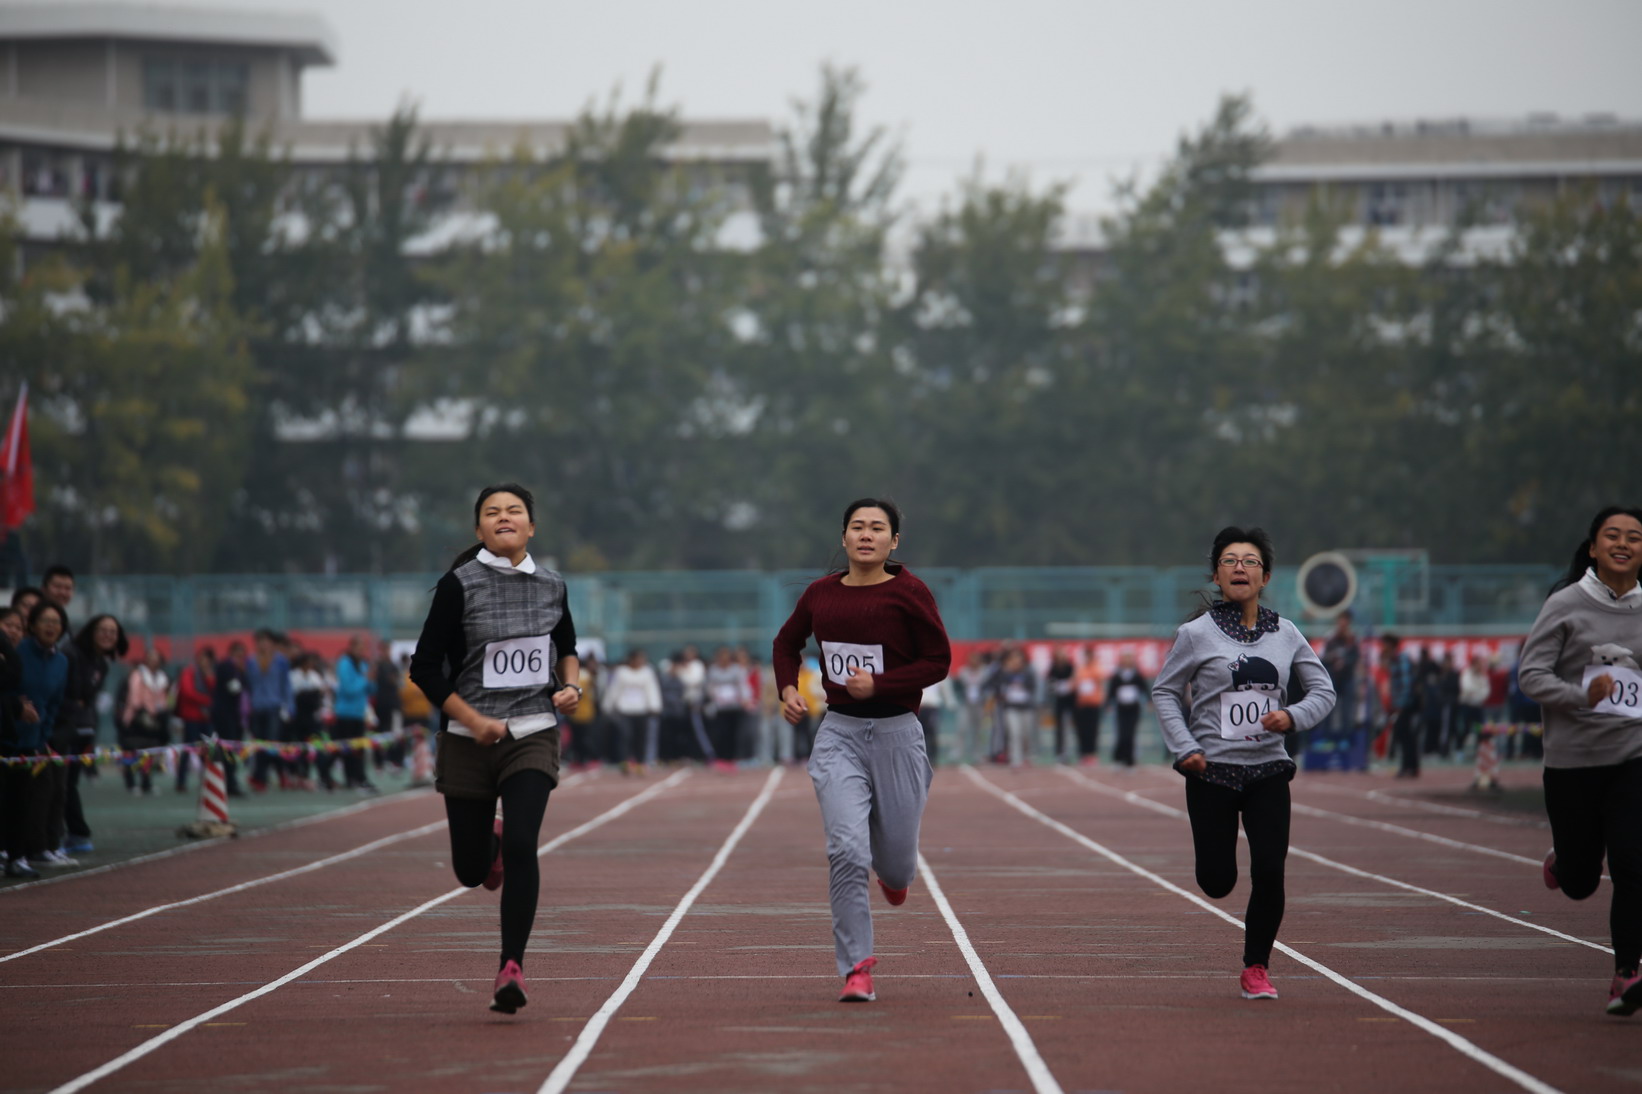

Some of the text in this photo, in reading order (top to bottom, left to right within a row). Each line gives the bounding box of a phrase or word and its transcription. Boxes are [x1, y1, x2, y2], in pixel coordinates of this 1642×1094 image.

[493, 649, 542, 674] 006
[831, 653, 875, 677] 005
[1608, 680, 1639, 707] 03
[1230, 697, 1270, 726] 004
